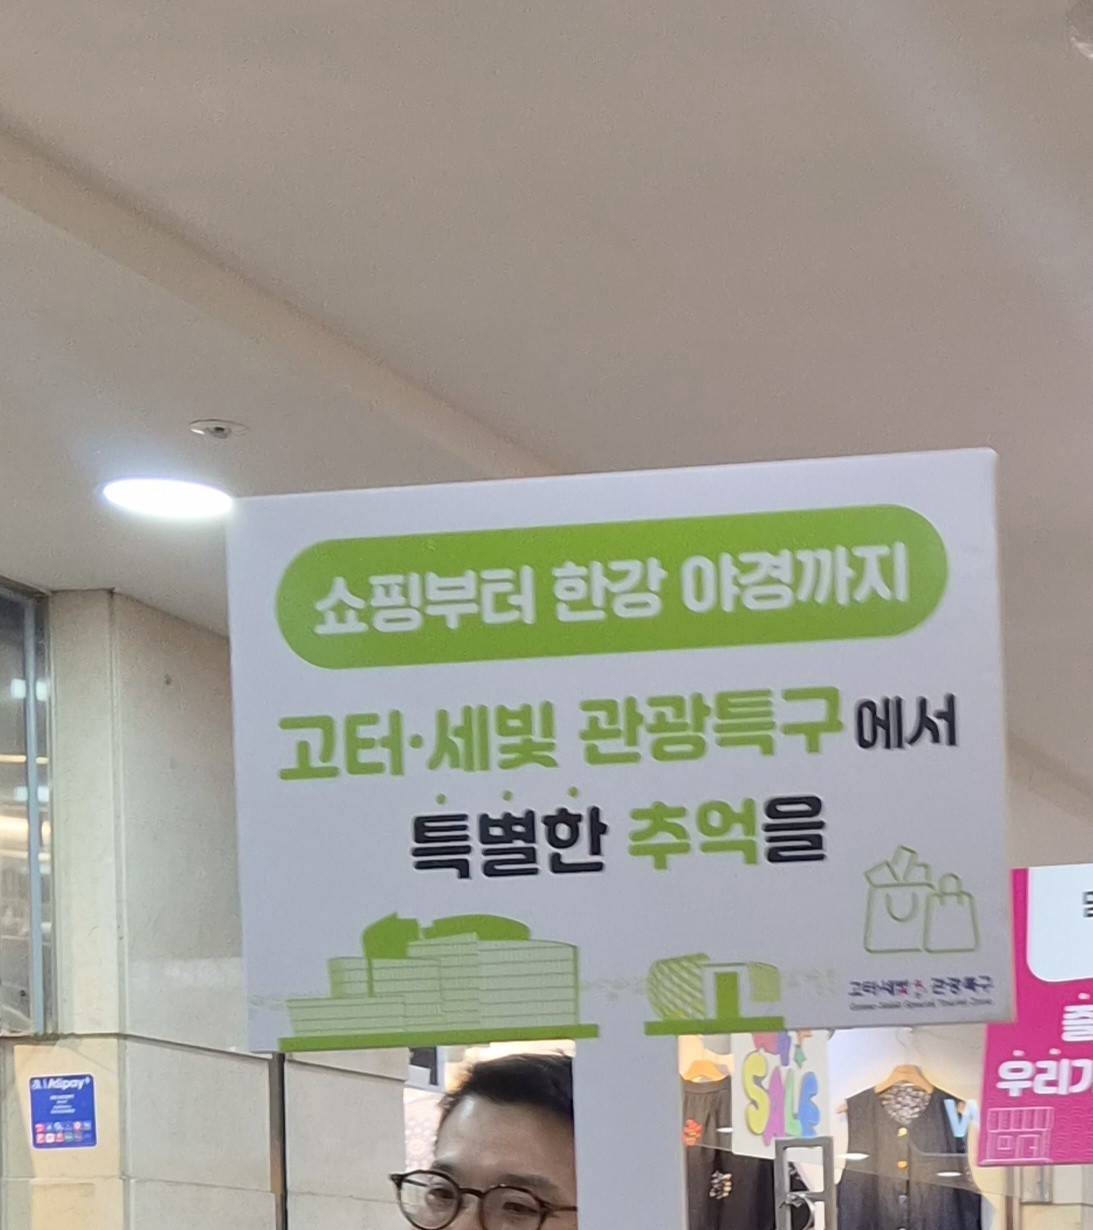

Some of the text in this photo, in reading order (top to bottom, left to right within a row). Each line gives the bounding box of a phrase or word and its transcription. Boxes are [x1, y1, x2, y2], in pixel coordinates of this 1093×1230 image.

[314, 542, 910, 635] 쇼핑부터 한강 야경까지
[412, 795, 827, 880] 특별한 추억을
